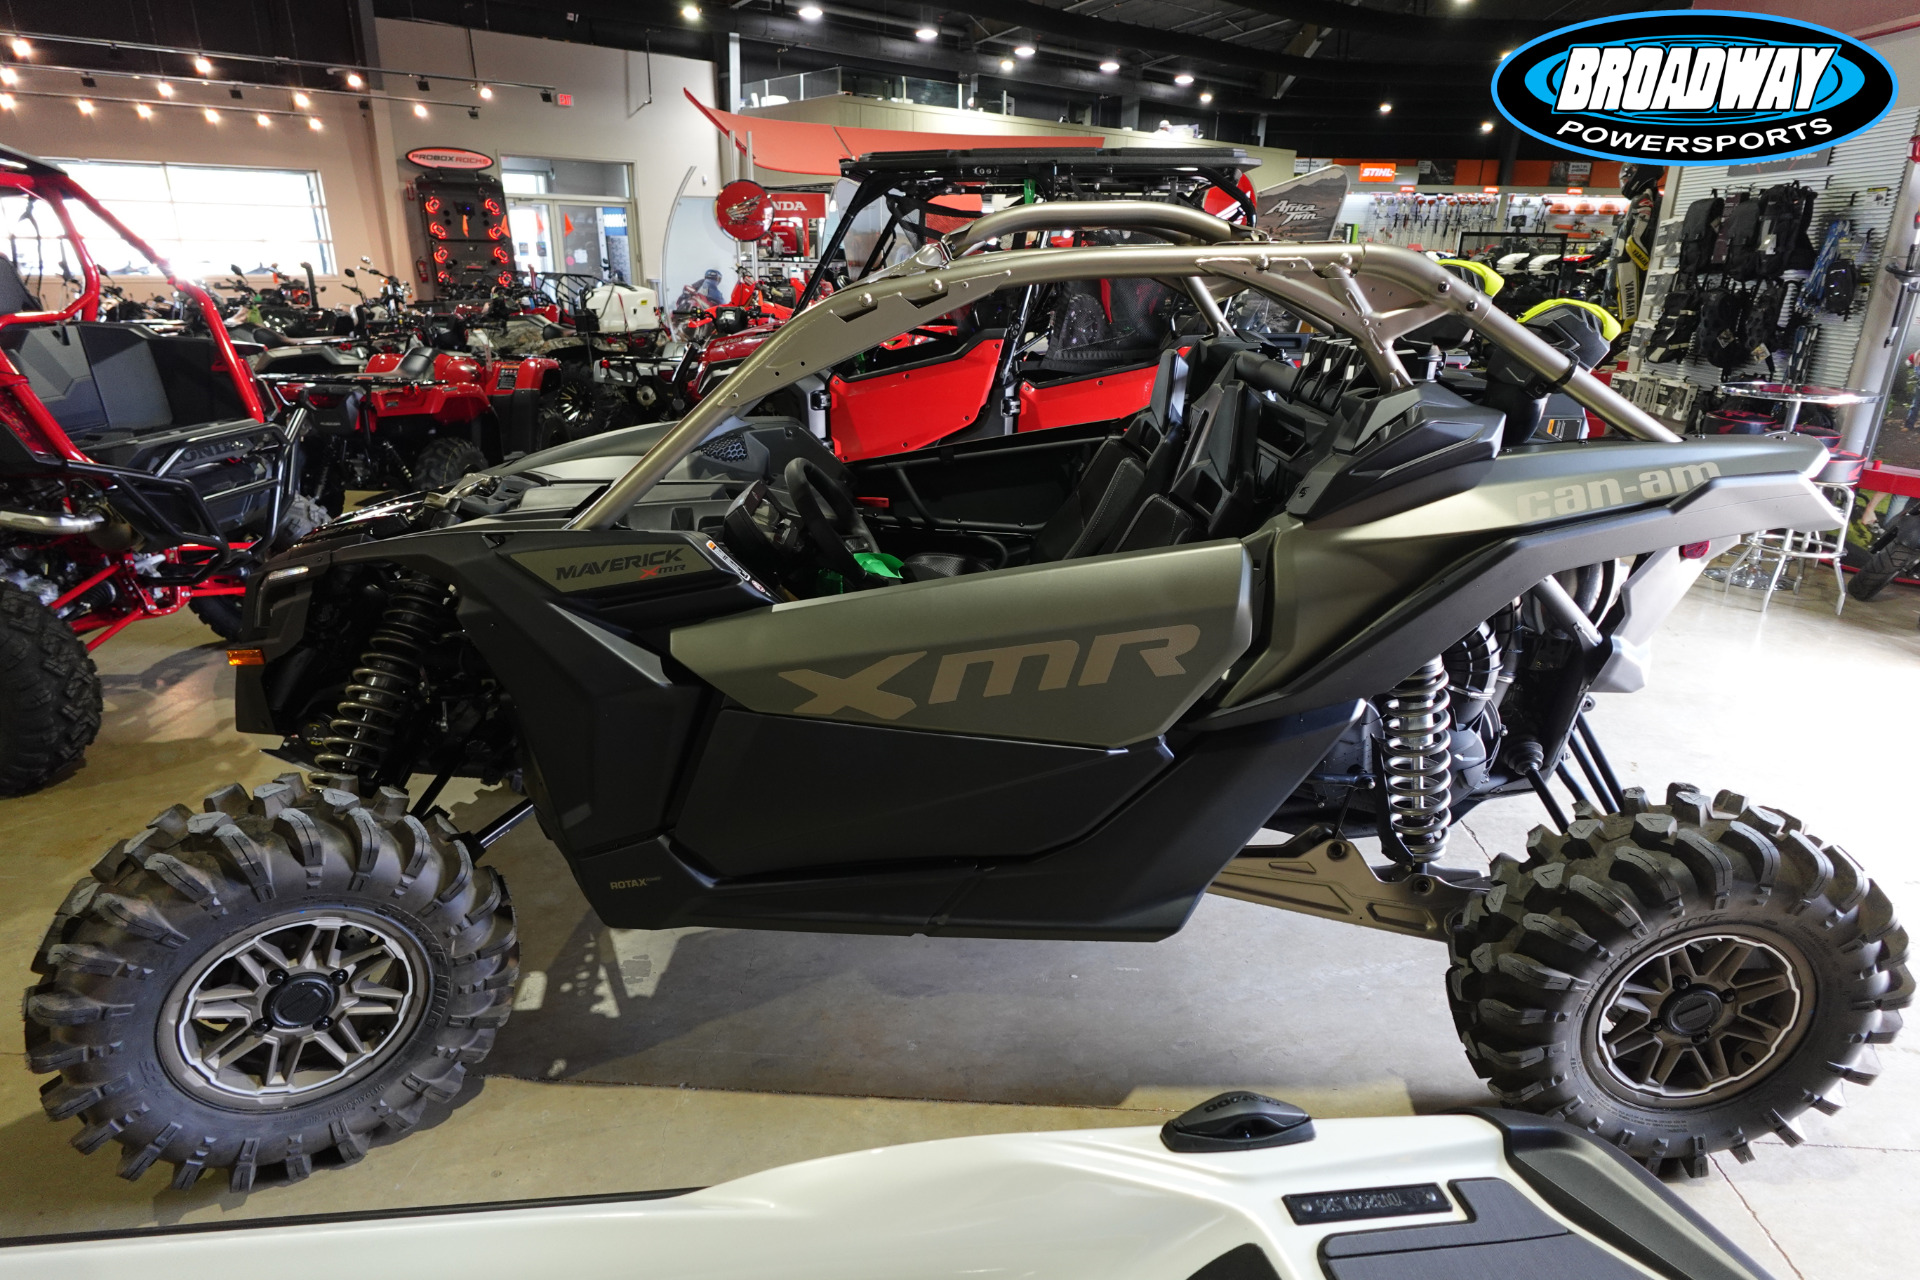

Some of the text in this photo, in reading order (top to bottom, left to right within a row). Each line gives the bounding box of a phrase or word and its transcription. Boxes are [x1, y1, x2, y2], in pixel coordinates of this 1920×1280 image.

[411, 153, 455, 162] PROBOX
[1361, 167, 1394, 177] STIHL
[773, 201, 808, 211] NDA
[1264, 200, 1320, 216] Africa
[1280, 211, 1323, 226] Twin
[1624, 280, 1636, 318] YAMAHA
[1516, 461, 1722, 523] can-am
[554, 547, 685, 581] MAVERICK
[609, 878, 648, 890] ROTAX
